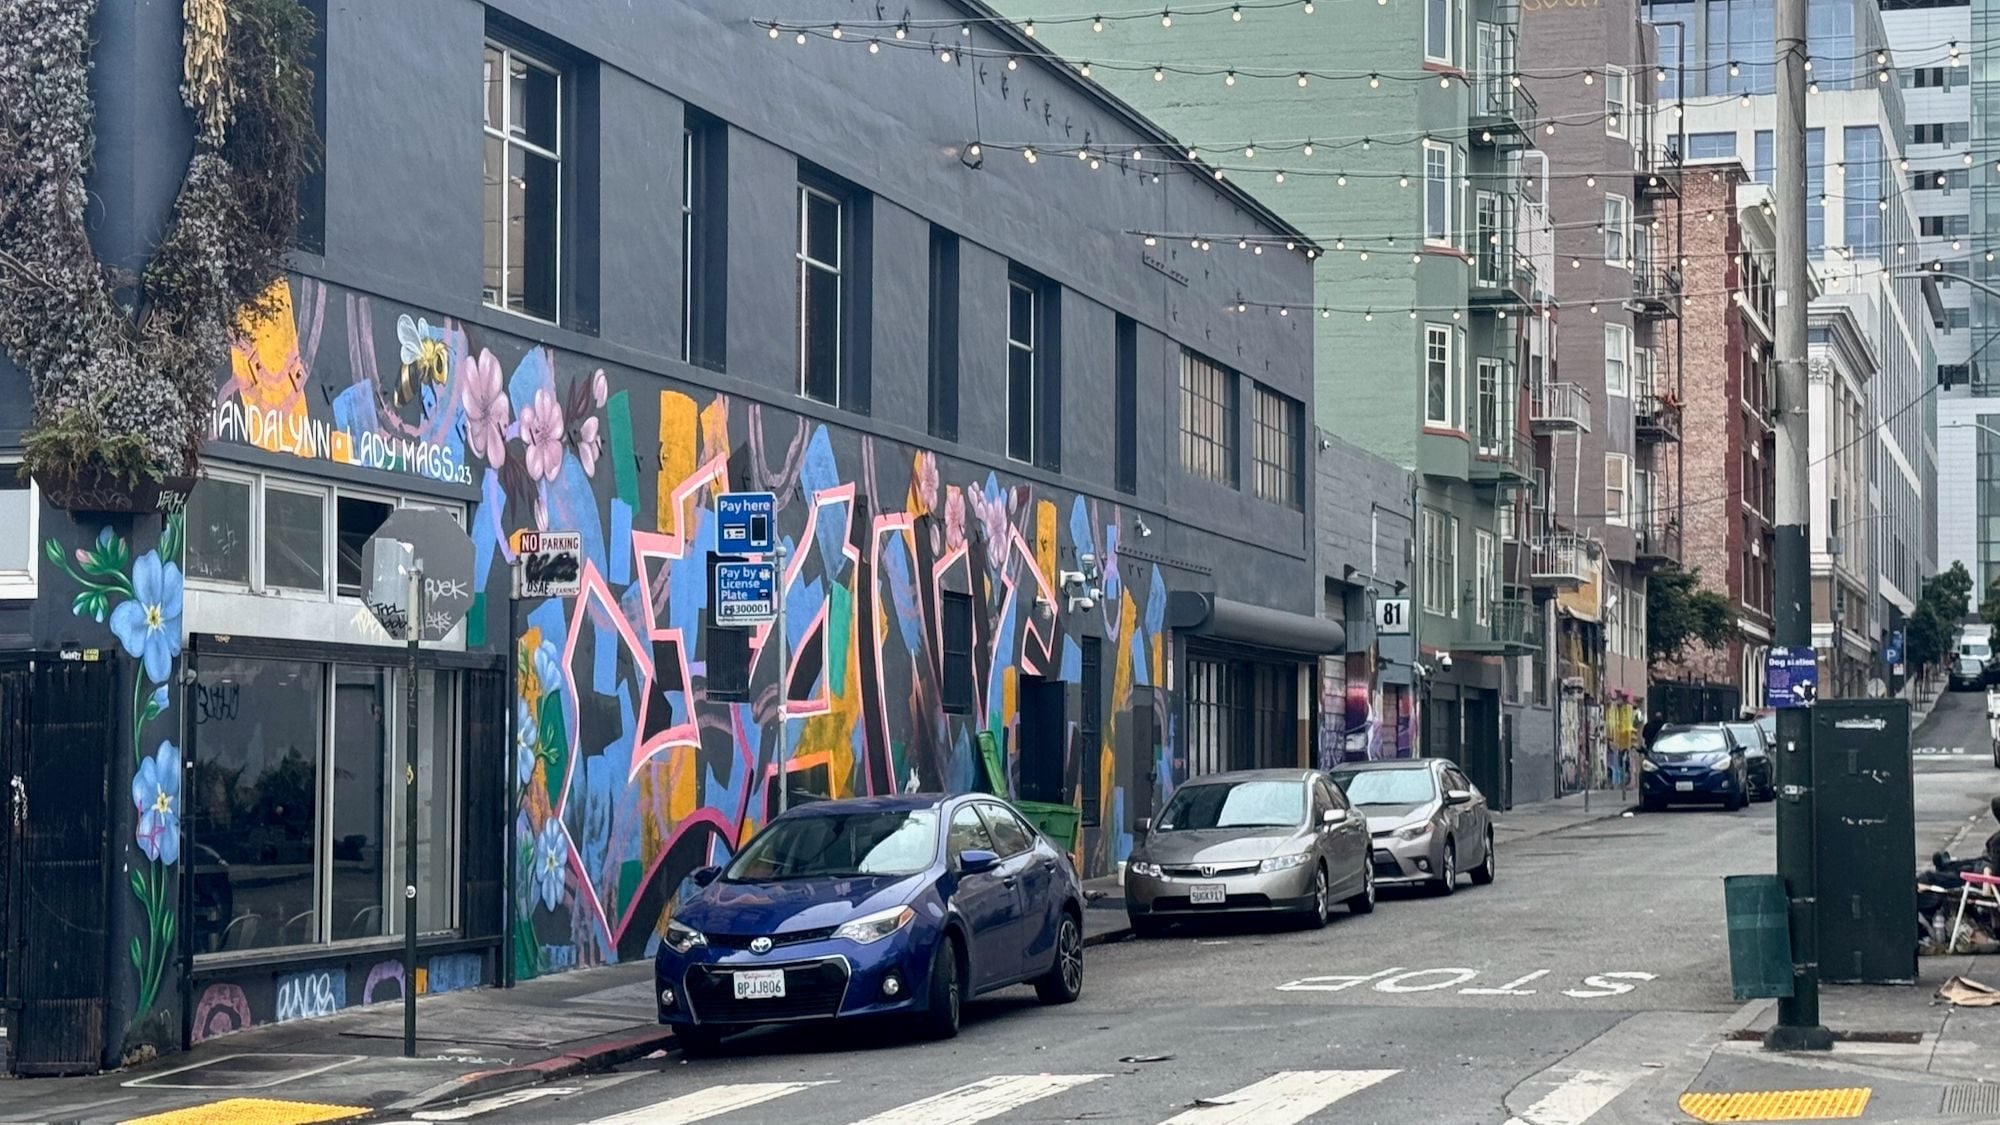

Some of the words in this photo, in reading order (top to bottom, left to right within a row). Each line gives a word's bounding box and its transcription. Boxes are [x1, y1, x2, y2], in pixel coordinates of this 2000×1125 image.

[347, 425, 397, 470] LADY
[720, 501, 742, 514] Pay
[744, 500, 770, 511] here
[522, 534, 537, 551] NO
[541, 537, 579, 550] PARKING
[720, 568, 740, 580] Pay
[743, 566, 757, 579] by
[721, 579, 760, 589] License
[721, 589, 748, 600] Plate
[1383, 603, 1401, 625] 81
[1886, 649, 1897, 661] P
[1768, 658, 1785, 668] Dog
[737, 980, 782, 995] 8PJJ806
[1276, 967, 1660, 998] STOP
